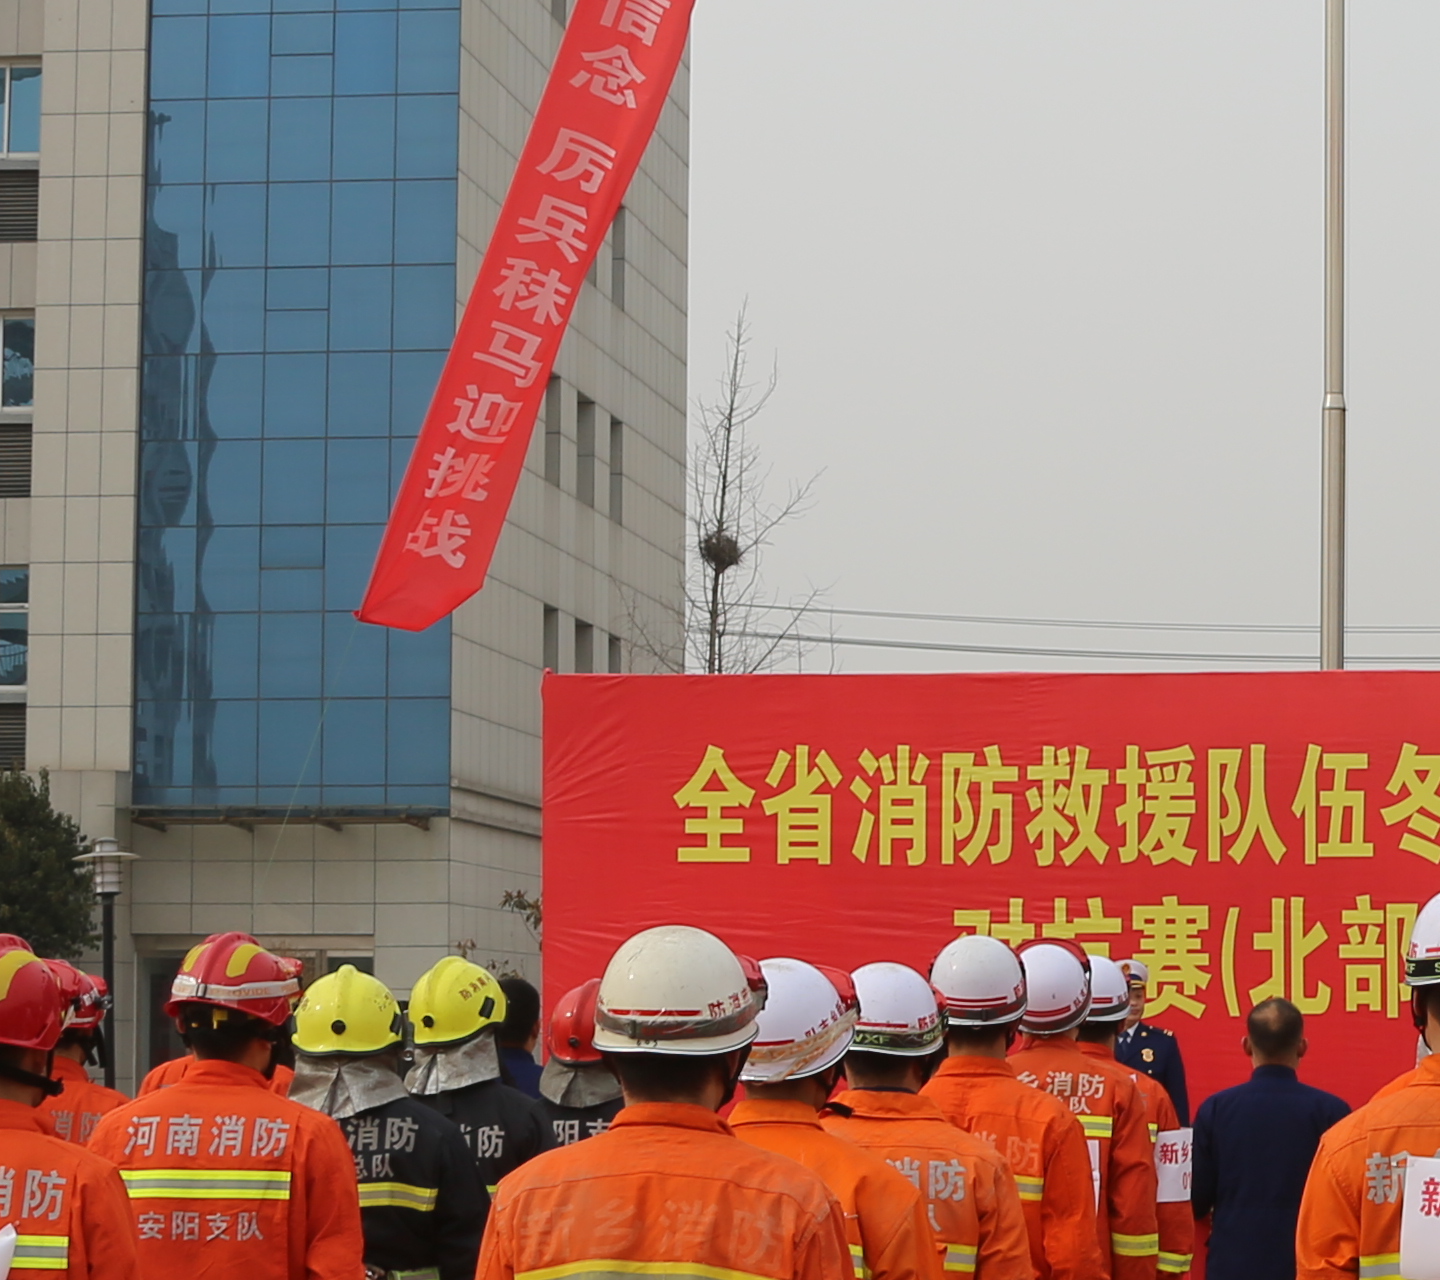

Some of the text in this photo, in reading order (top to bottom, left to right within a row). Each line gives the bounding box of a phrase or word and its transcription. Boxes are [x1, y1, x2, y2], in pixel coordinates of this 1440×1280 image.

[406, 124, 615, 570] 厉兵秣马迎挑战
[124, 1113, 292, 1159] 河南消防
[137, 1210, 265, 1244] 安阳支队
